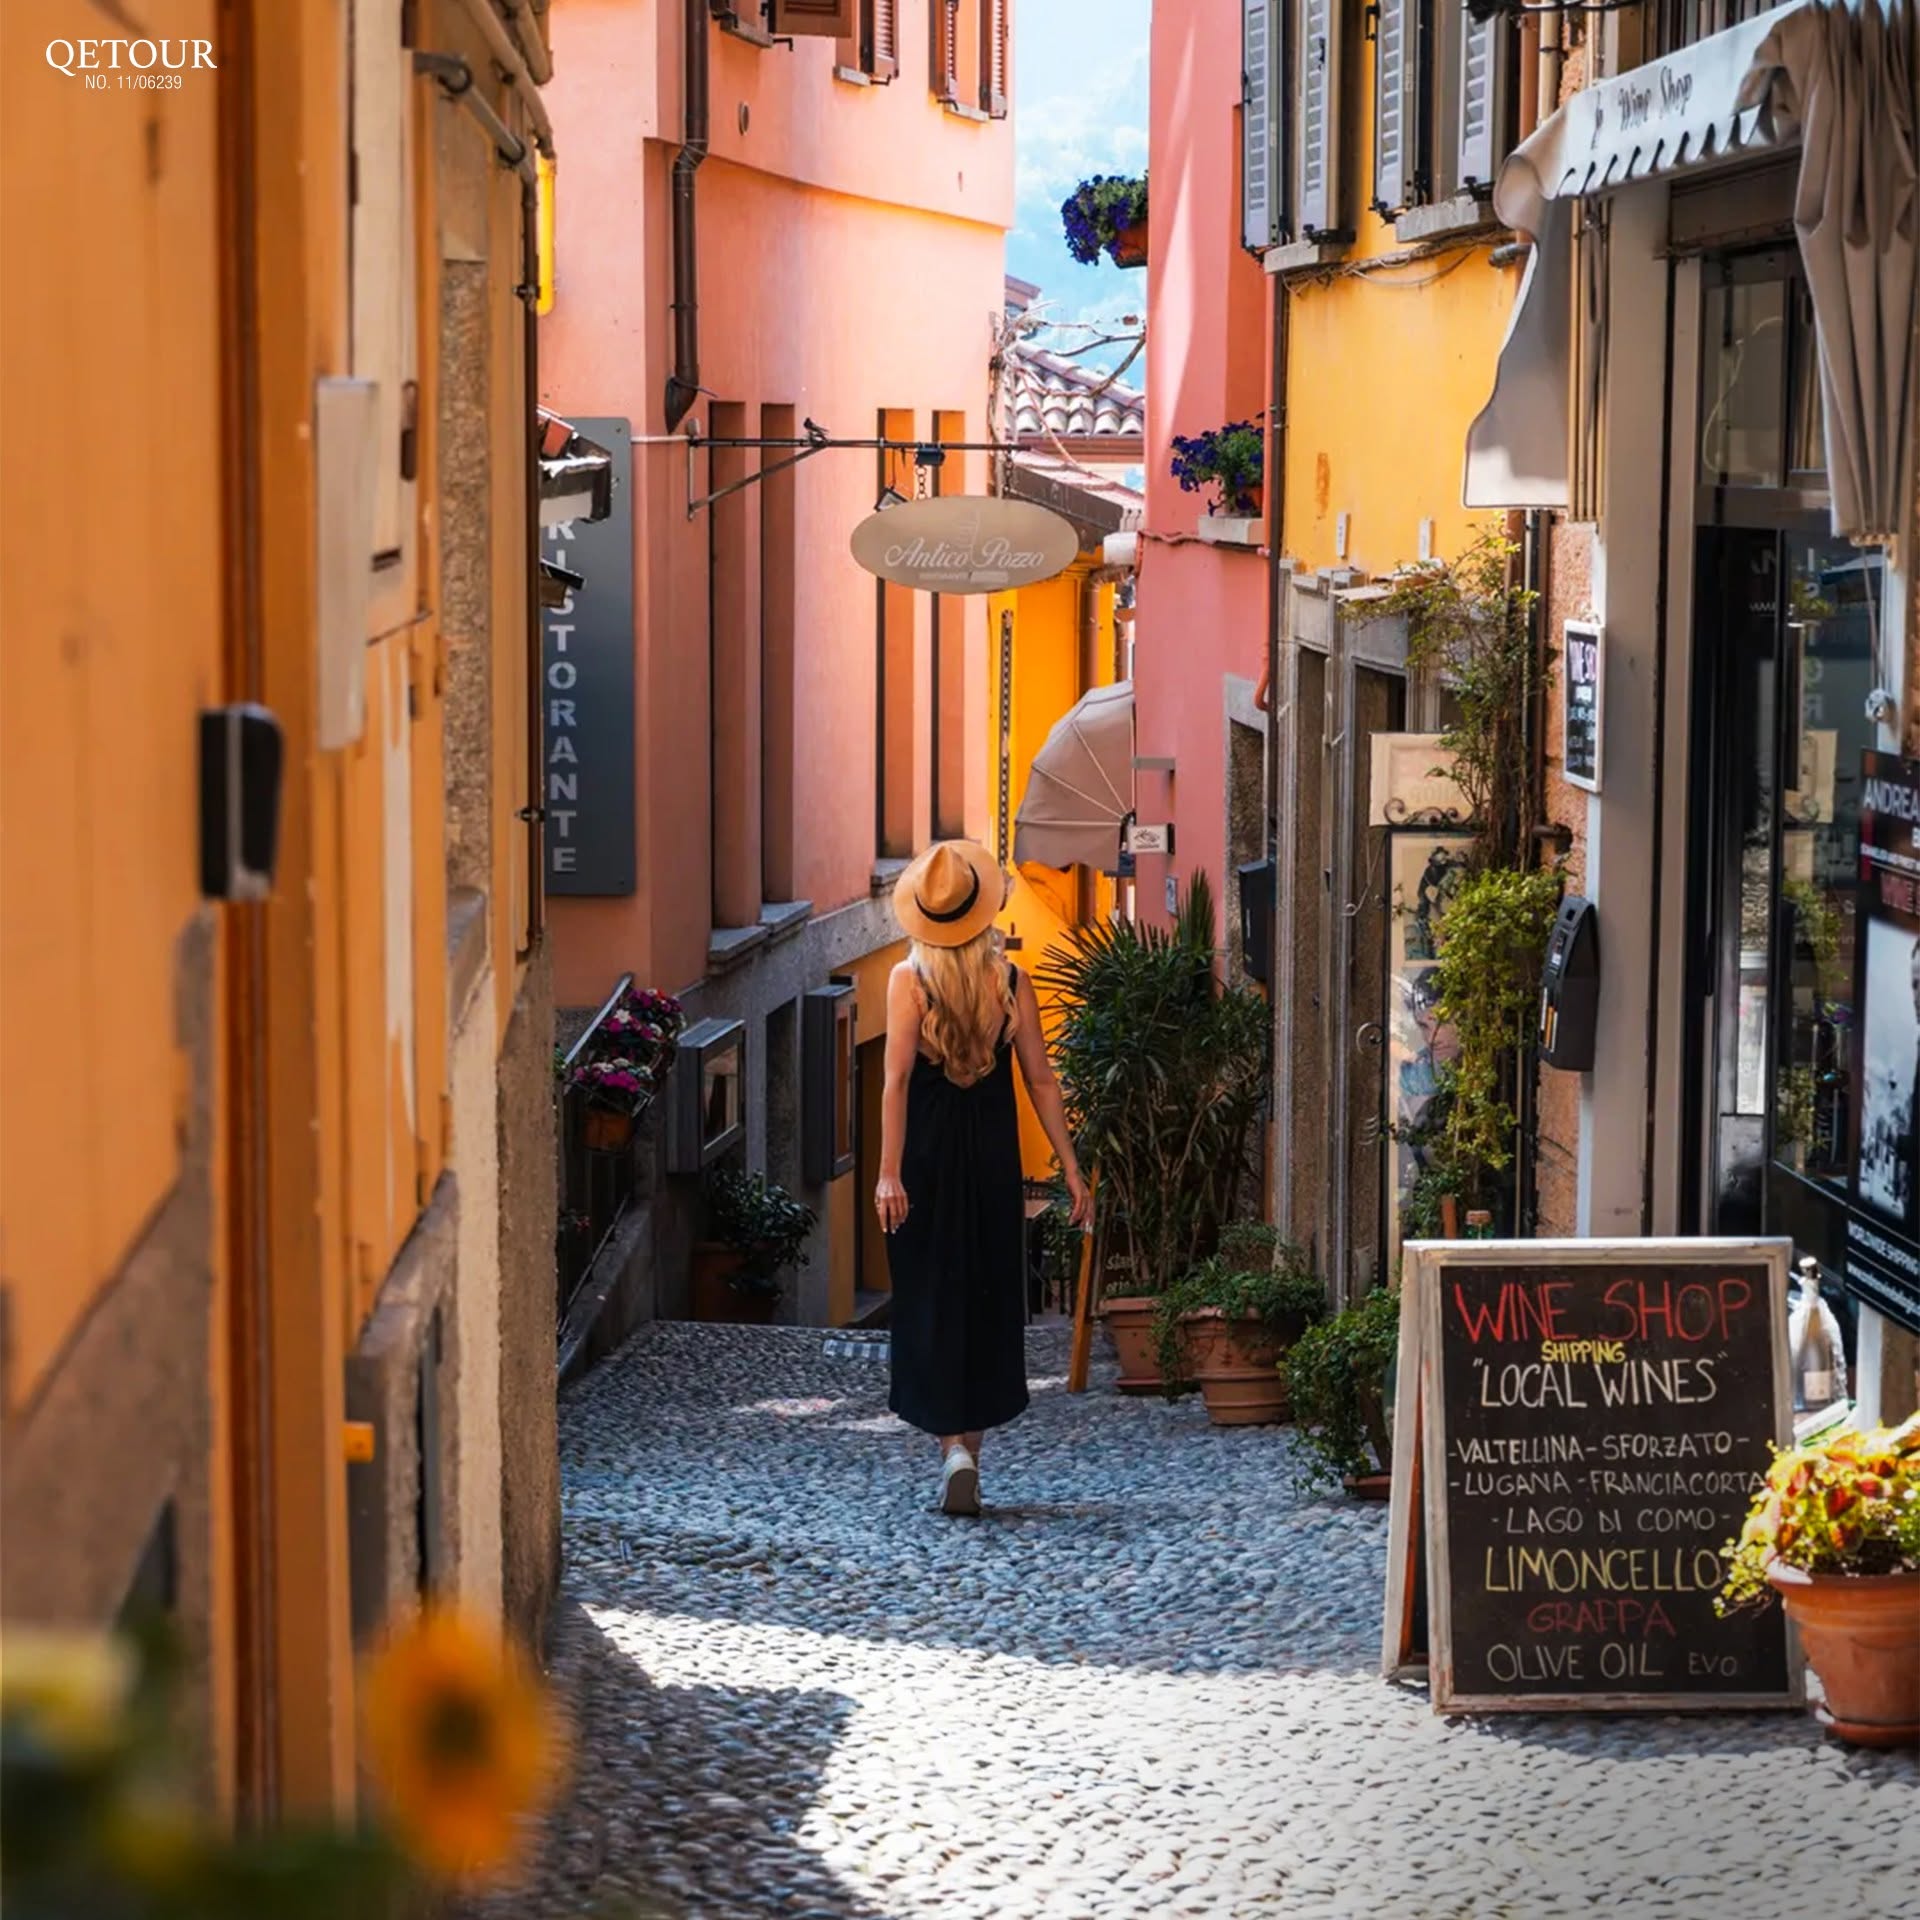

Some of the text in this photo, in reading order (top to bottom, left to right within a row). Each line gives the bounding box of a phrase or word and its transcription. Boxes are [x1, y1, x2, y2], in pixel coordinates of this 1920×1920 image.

[884, 537, 1044, 568] Antico Pozzo
[1454, 1279, 1751, 1343] WINE SHOP
[1541, 1340, 1626, 1363] SHIPPING
[1600, 1508, 1622, 1532] DI
[1485, 1546, 1722, 1593] LIMONCELLO
[1526, 1599, 1677, 1638] GRAPPA
[1487, 1642, 1737, 1683] OLIVE OIL EVO
